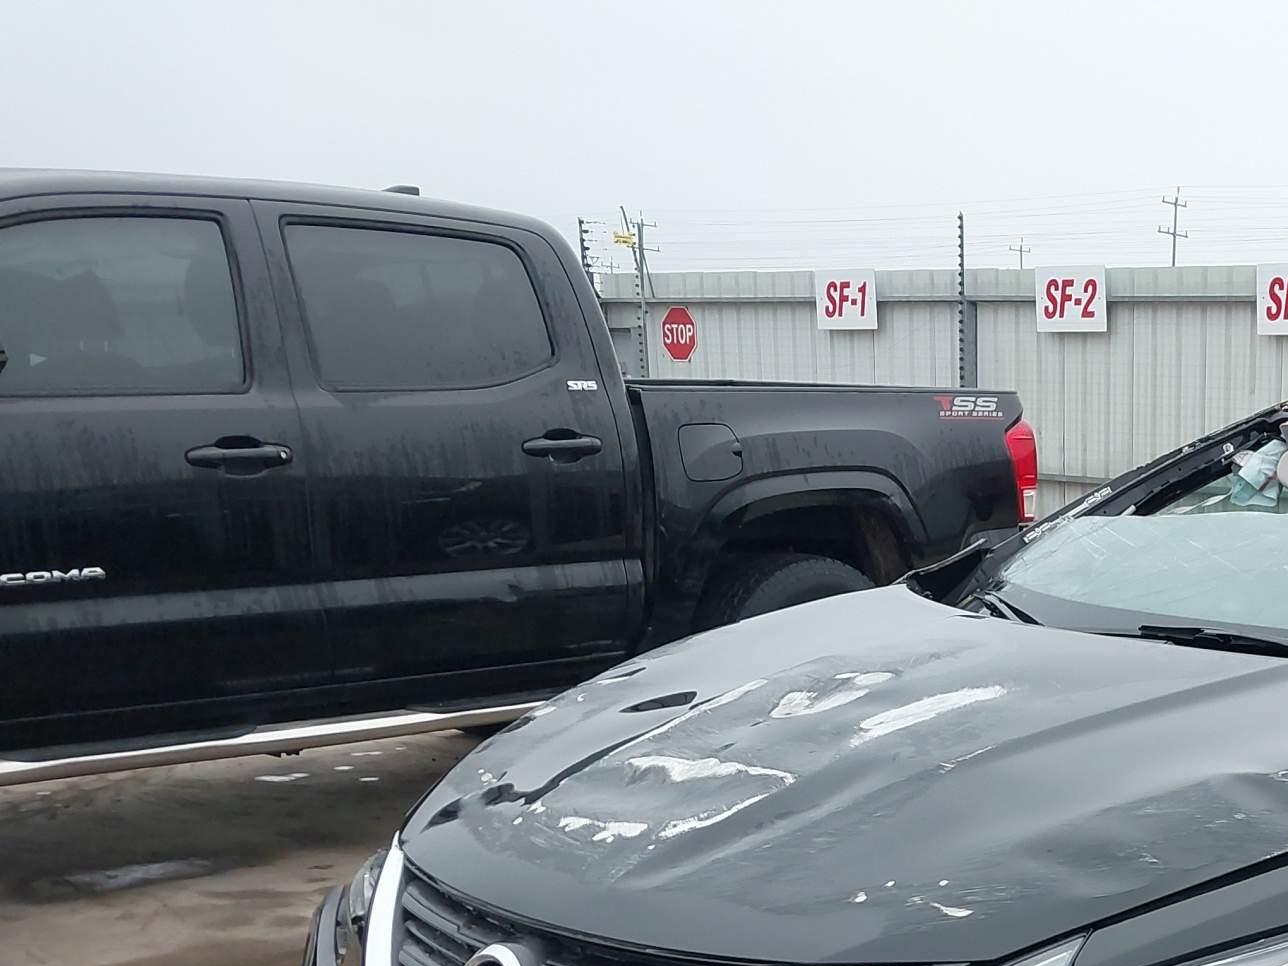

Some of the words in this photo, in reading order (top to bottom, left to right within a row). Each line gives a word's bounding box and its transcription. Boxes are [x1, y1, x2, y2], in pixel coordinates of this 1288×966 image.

[825, 280, 868, 318] SF-1
[1043, 278, 1098, 319] SF-2
[664, 324, 694, 344] STOP
[933, 395, 998, 411] TSS
